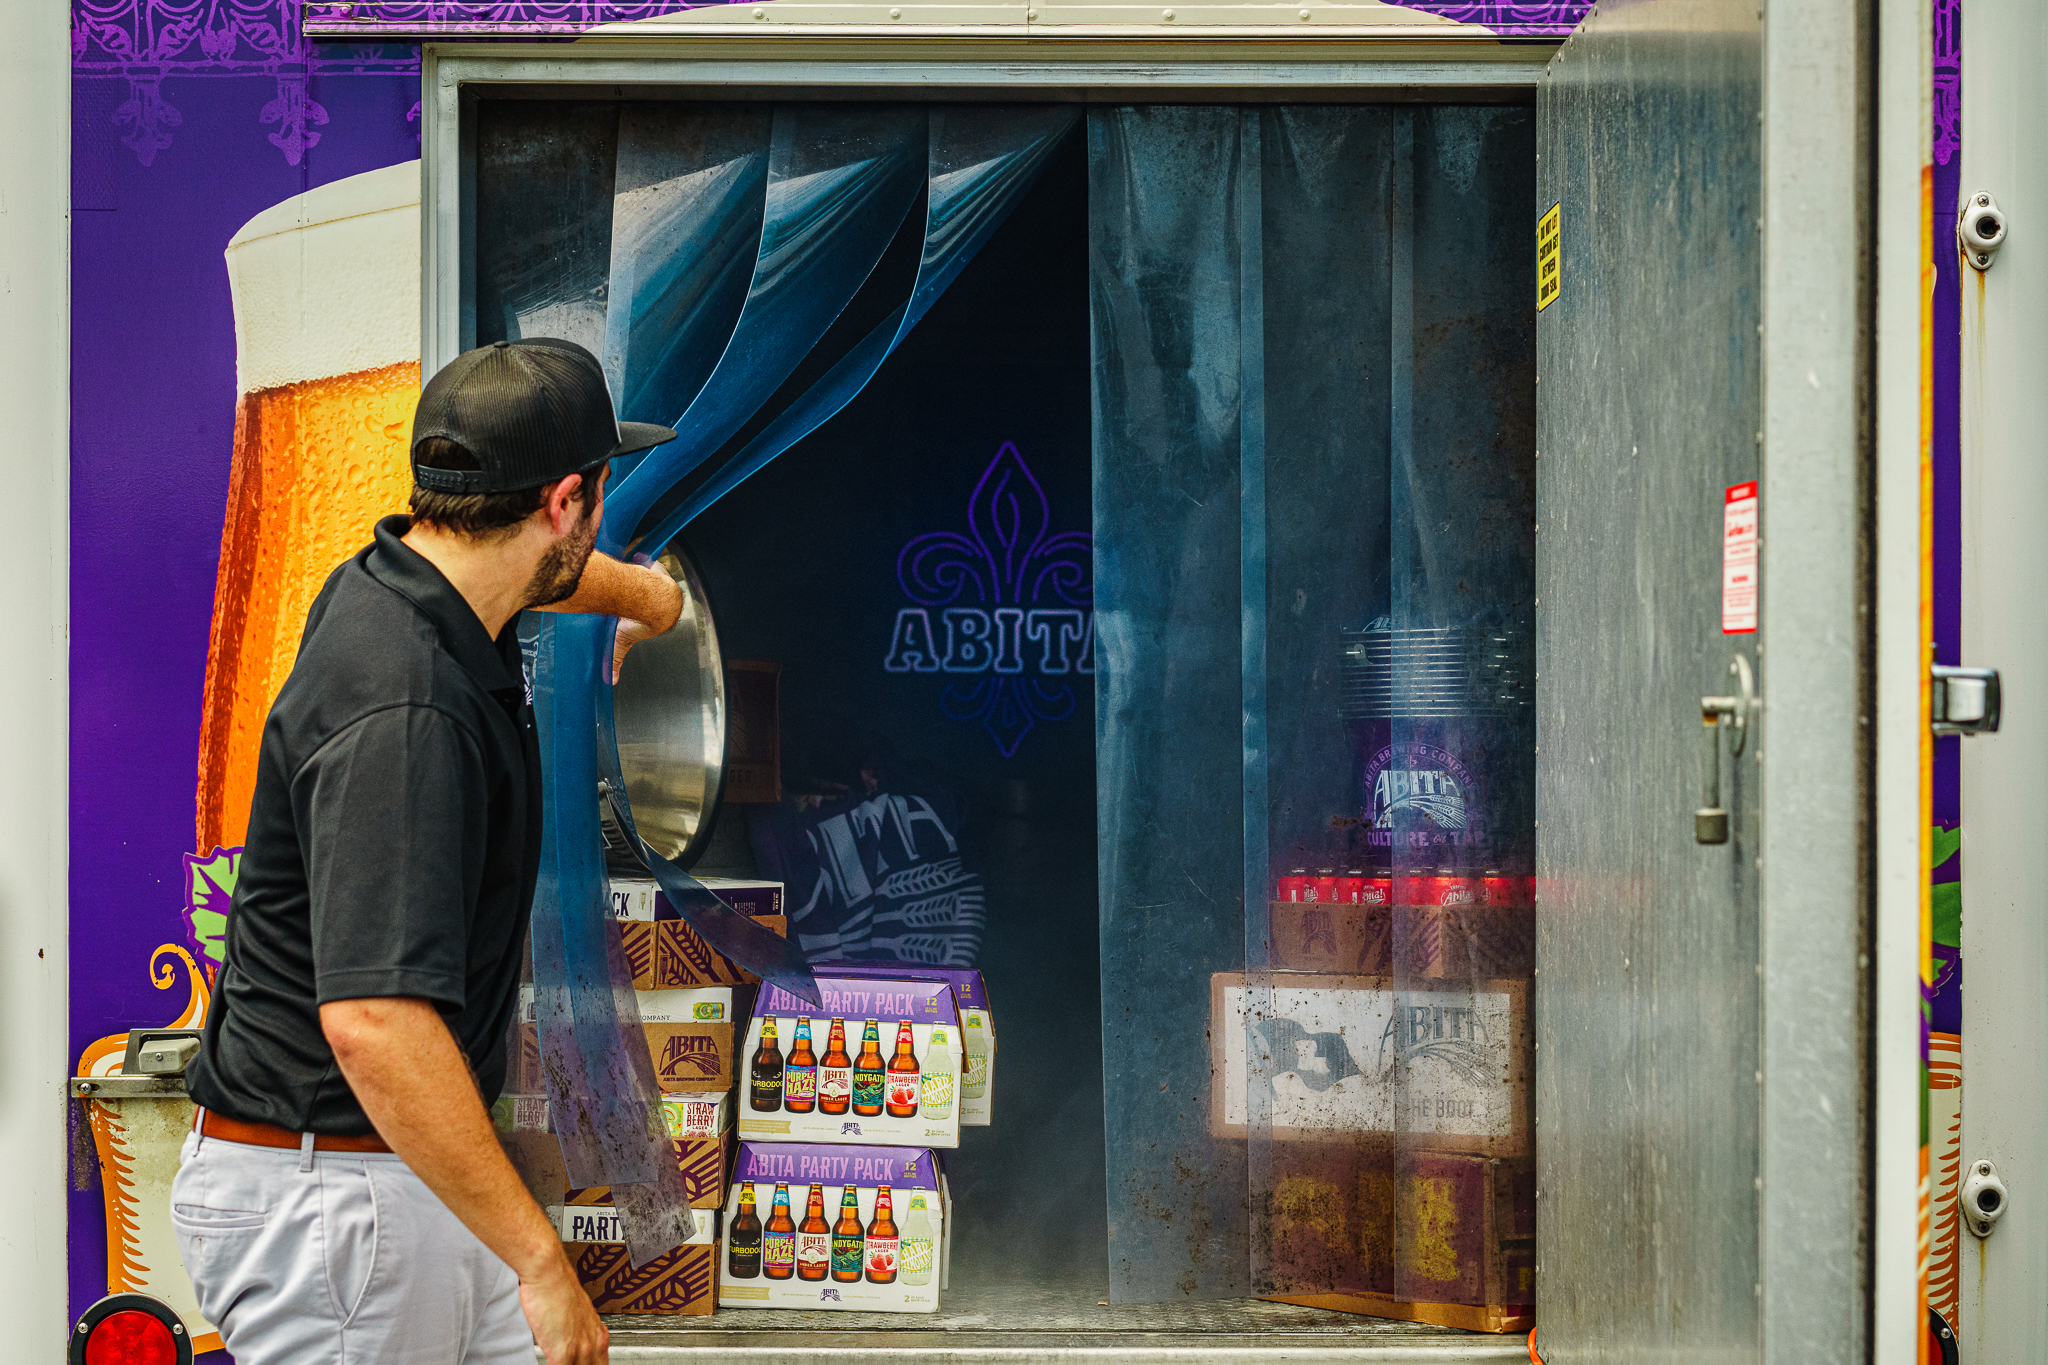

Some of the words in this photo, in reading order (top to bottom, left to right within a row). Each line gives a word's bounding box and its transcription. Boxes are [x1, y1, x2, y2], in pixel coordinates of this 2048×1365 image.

[1365, 760, 1380, 788] ABITA
[1431, 750, 1477, 788] COMPANY
[1374, 770, 1461, 820] ABITA
[1367, 832, 1429, 847] CULTURE
[1449, 831, 1484, 846] TAP
[613, 892, 630, 916] CK
[961, 983, 971, 992] 12
[823, 990, 870, 1015] PARTY
[875, 993, 914, 1016] PACK
[926, 997, 937, 1006] 12
[1378, 1006, 1490, 1074] ABITA
[659, 1036, 718, 1071] ABITA
[969, 1058, 985, 1071] ARD
[787, 1072, 815, 1083] PURPLE
[822, 1070, 848, 1084] ABITA
[786, 1079, 815, 1093] HAZE
[923, 1076, 950, 1094] HARD
[518, 1099, 546, 1112] STRAW
[687, 1103, 714, 1115] STRAW
[1411, 1099, 1429, 1118] HE
[1436, 1099, 1475, 1118] BOOT
[518, 1111, 545, 1124] BERRY
[687, 1115, 714, 1128] BERRY
[841, 1122, 861, 1131] ABITA
[747, 1154, 794, 1177] ABITA
[800, 1156, 849, 1179] PARTY
[854, 1158, 893, 1181] PACK
[905, 1162, 916, 1171] 12
[573, 1216, 626, 1240] PART
[765, 1238, 794, 1249] PURPLE
[801, 1236, 826, 1250] ABITA
[902, 1242, 929, 1258] HARD
[766, 1245, 794, 1260] HAZE
